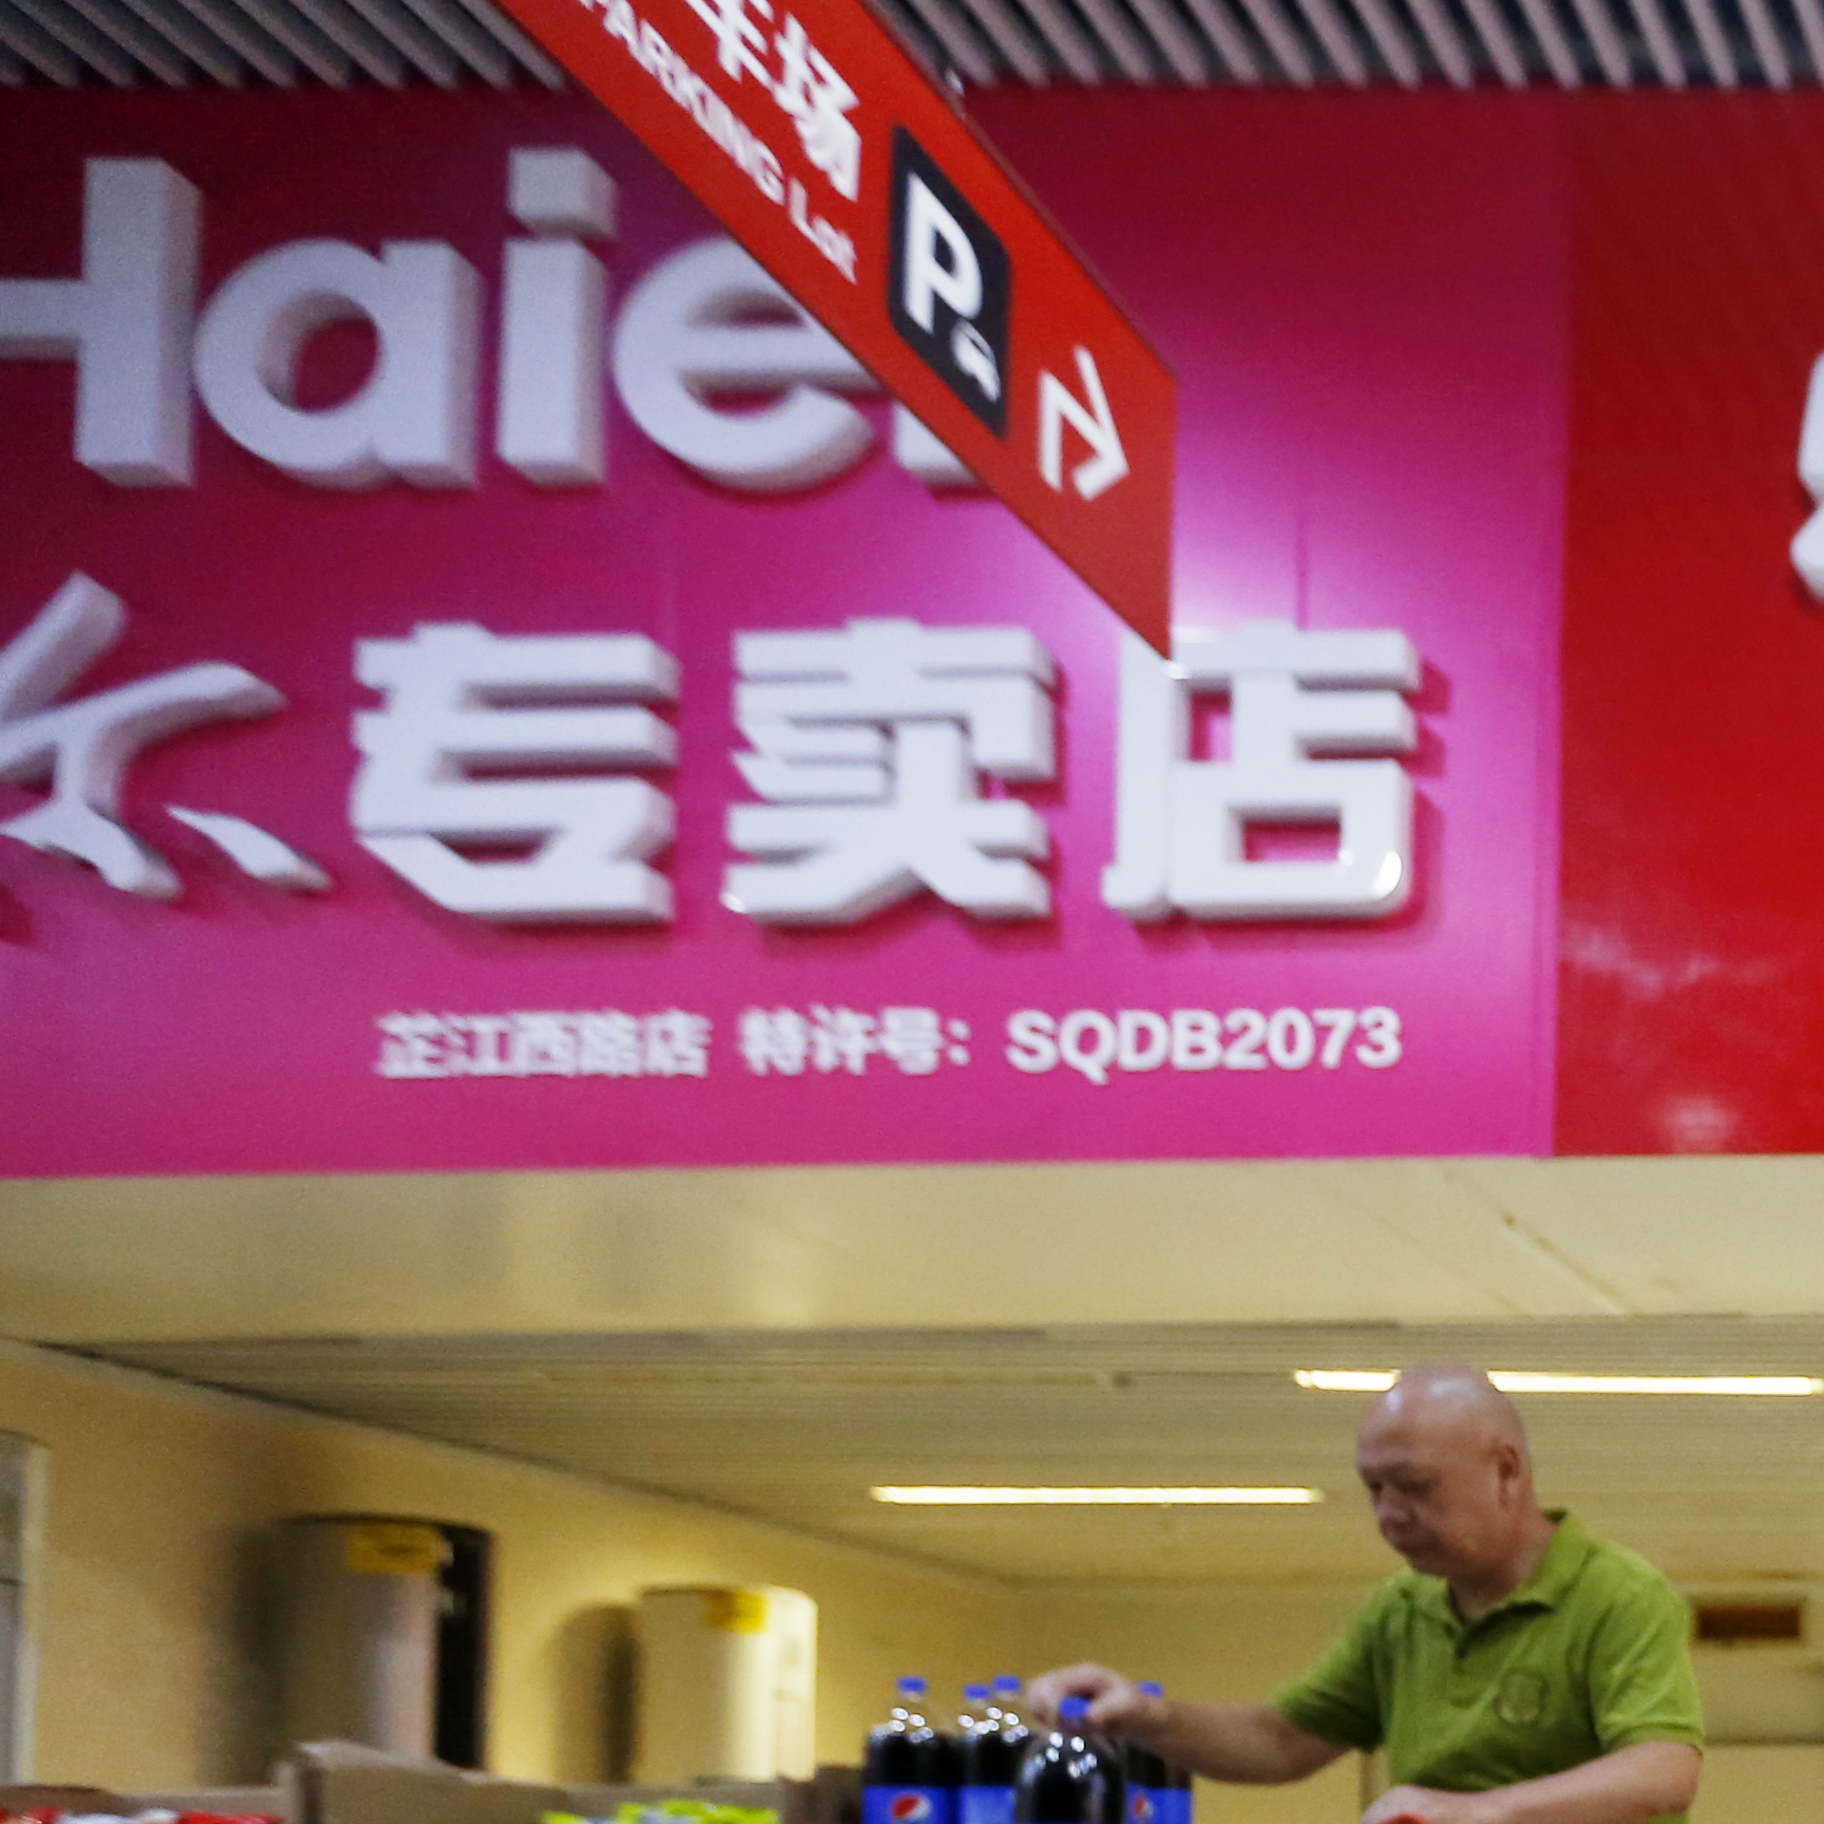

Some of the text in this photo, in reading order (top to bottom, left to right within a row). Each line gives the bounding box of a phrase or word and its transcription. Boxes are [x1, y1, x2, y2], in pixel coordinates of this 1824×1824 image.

[577, 0, 858, 285] ARKING Lot
[1005, 1007, 1402, 1084] SQDB2073
